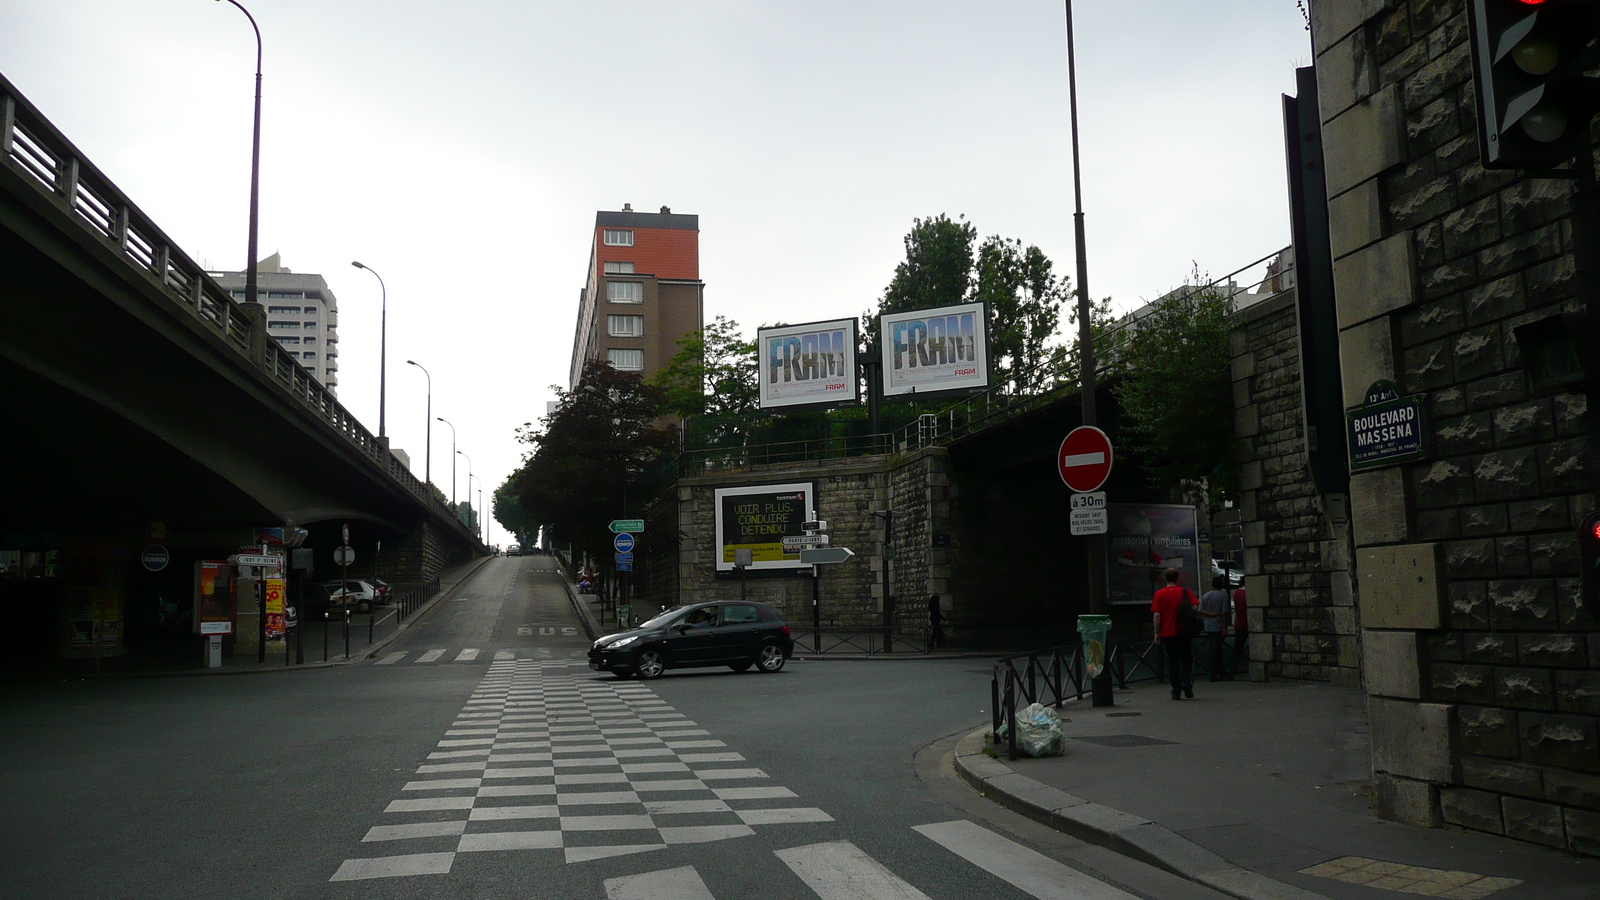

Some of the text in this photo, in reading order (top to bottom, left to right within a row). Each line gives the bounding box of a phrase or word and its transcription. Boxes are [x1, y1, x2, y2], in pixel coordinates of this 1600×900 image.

[893, 313, 975, 369] FRAM
[770, 331, 844, 384] FRAM
[954, 368, 976, 377] FRAM
[825, 383, 845, 391] FRAM
[1354, 407, 1413, 432] BOULEVARD
[1358, 423, 1412, 446] MASSENA
[1072, 496, 1104, 508] à 30m
[734, 502, 794, 515] VOIR PLUS.
[738, 513, 789, 525] CONDUIRE
[741, 524, 786, 535] DETENDU
[1154, 535, 1191, 548] singulières
[517, 627, 578, 636] BUS
